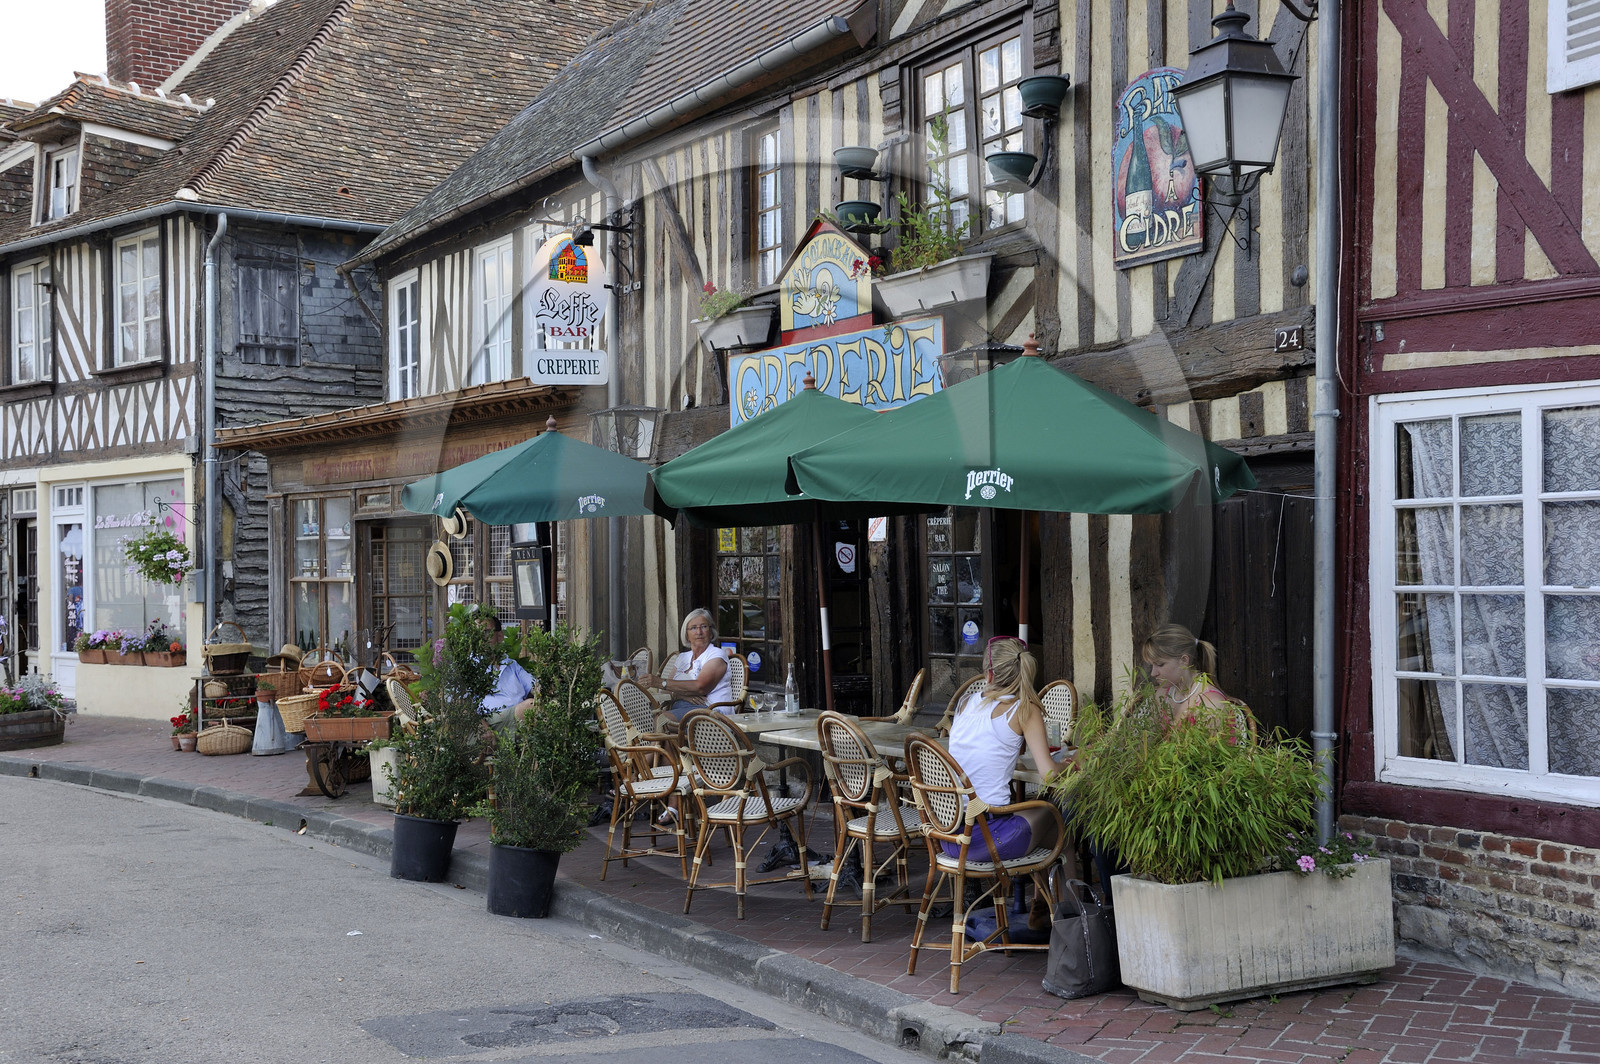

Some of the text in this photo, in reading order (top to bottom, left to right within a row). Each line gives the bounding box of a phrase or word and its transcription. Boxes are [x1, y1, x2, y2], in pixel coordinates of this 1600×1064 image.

[536, 286, 599, 327] Leffe
[550, 326, 588, 337] BAR
[1279, 330, 1299, 348] 24
[537, 358, 600, 375] CREPERIE
[934, 534, 946, 542] BAR
[516, 549, 537, 559] MENU
[932, 563, 950, 573] SALON
[938, 575, 946, 583] DE
